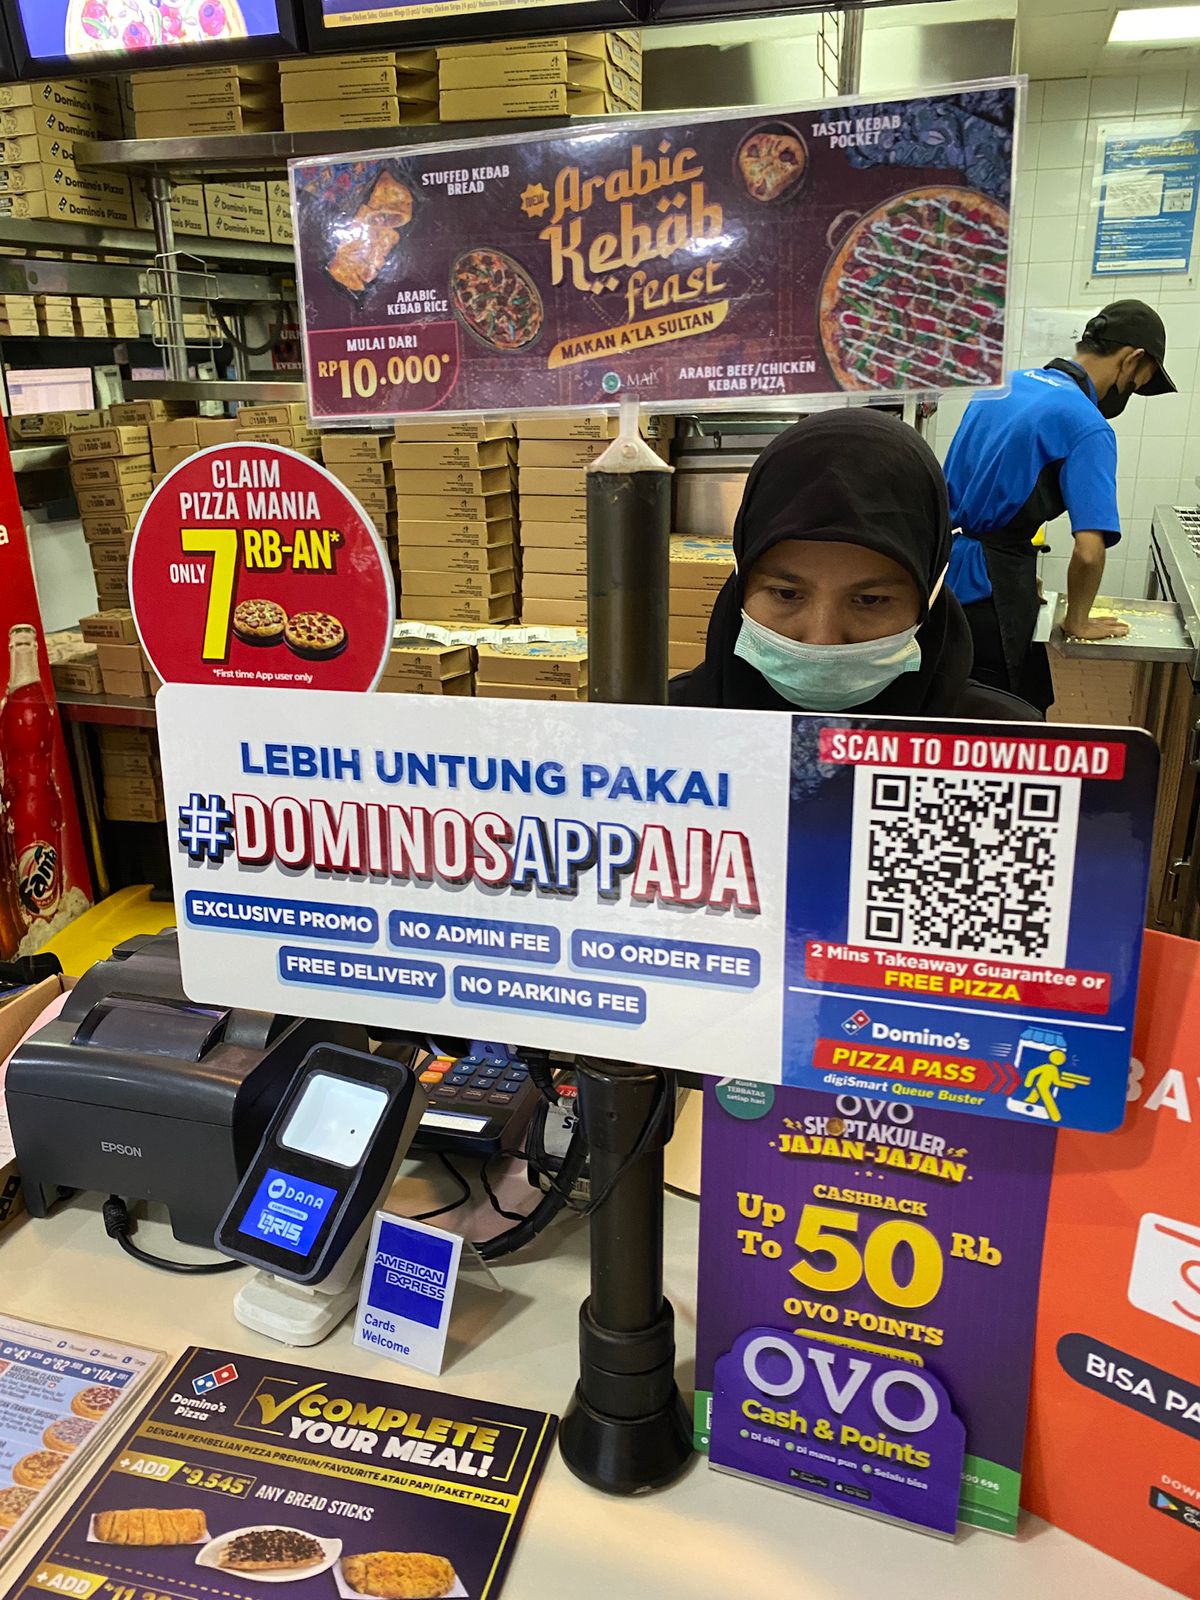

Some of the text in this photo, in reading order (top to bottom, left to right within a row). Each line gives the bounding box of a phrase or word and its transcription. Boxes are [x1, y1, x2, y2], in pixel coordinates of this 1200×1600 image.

[811, 114, 901, 138] TASTY KEBAB
[829, 132, 881, 149] POCKET
[422, 165, 510, 186] STUFFED KEBAB
[447, 180, 484, 196] BREAD
[550, 139, 704, 225] Arabic
[526, 194, 544, 207] NEW
[397, 290, 436, 303] ARABIC
[626, 258, 727, 323] feast
[387, 300, 448, 316] KEBAB RICE
[346, 335, 418, 352] MULAI DARI
[561, 334, 617, 360] MAKAN
[659, 311, 714, 336] SULTAN
[679, 363, 723, 380] ARABIC
[727, 360, 816, 378] BEEF/CHICKEN
[707, 376, 785, 391] KEBAB PIZZA
[212, 460, 280, 488] CLAIM
[179, 492, 321, 520] PIZZA MANIA
[169, 564, 206, 584] ONLY
[181, 529, 237, 660] 7
[235, 670, 254, 680] time
[256, 671, 274, 682] App
[274, 673, 293, 682] user
[294, 672, 313, 684] only
[831, 734, 1110, 775] SCAN TO DOWNLOAD
[240, 742, 729, 807] LEBIH UNTUNG PAKAI
[179, 793, 760, 915] #DOMINOSAPPAJA
[192, 900, 373, 933] EXCLUSIVE PROMO
[399, 920, 550, 952] NO ADMIN FEE
[286, 956, 437, 988] FREE DELIVERY
[581, 941, 751, 976] NO ORDER FEE
[811, 944, 1106, 990] 2 Mins Takeaway Guarantee or
[461, 976, 640, 1014] NO PARKING FEE
[884, 971, 1021, 1002] FREE PIZZA
[871, 1022, 971, 1051] Domino's
[832, 1047, 977, 1084] PIZZA PASS
[823, 1073, 985, 1106] digiSmart Queue Buster
[836, 1094, 914, 1125] OVO
[101, 1141, 142, 1158] EPSON
[778, 1134, 966, 1182] JAJAN-JAJAN
[285, 1187, 324, 1209] DANA
[736, 1192, 786, 1228] Up
[813, 1184, 928, 1217] CASHBACK
[737, 1229, 783, 1259] To
[789, 1204, 1002, 1309] 50 Rb
[375, 1252, 443, 1283] AMERICAN
[387, 1272, 445, 1300] EXPRESS
[364, 1313, 396, 1333] Cards
[783, 1297, 945, 1346] OVO POINTS
[362, 1328, 410, 1356] Welcome
[743, 1336, 939, 1433] OVO
[1086, 1353, 1157, 1404] BISA
[171, 1393, 227, 1413] Domino's
[174, 1406, 209, 1421] Pizza
[298, 1393, 500, 1454] COMPLETE
[741, 1398, 931, 1469] Cash & Points
[146, 1425, 186, 1440] DENGAN
[189, 1433, 242, 1452] PEMBELIAN
[242, 1445, 272, 1459] PIZZA
[272, 1450, 380, 1481] PREMIUM/FAVOURITE
[380, 1473, 407, 1487] ATAU
[408, 1478, 434, 1491] PAPI
[287, 1417, 495, 1478] YOUR MEAL!
[256, 1485, 283, 1503] ANY
[284, 1490, 326, 1511] BREAD
[328, 1501, 374, 1521] STICKS
